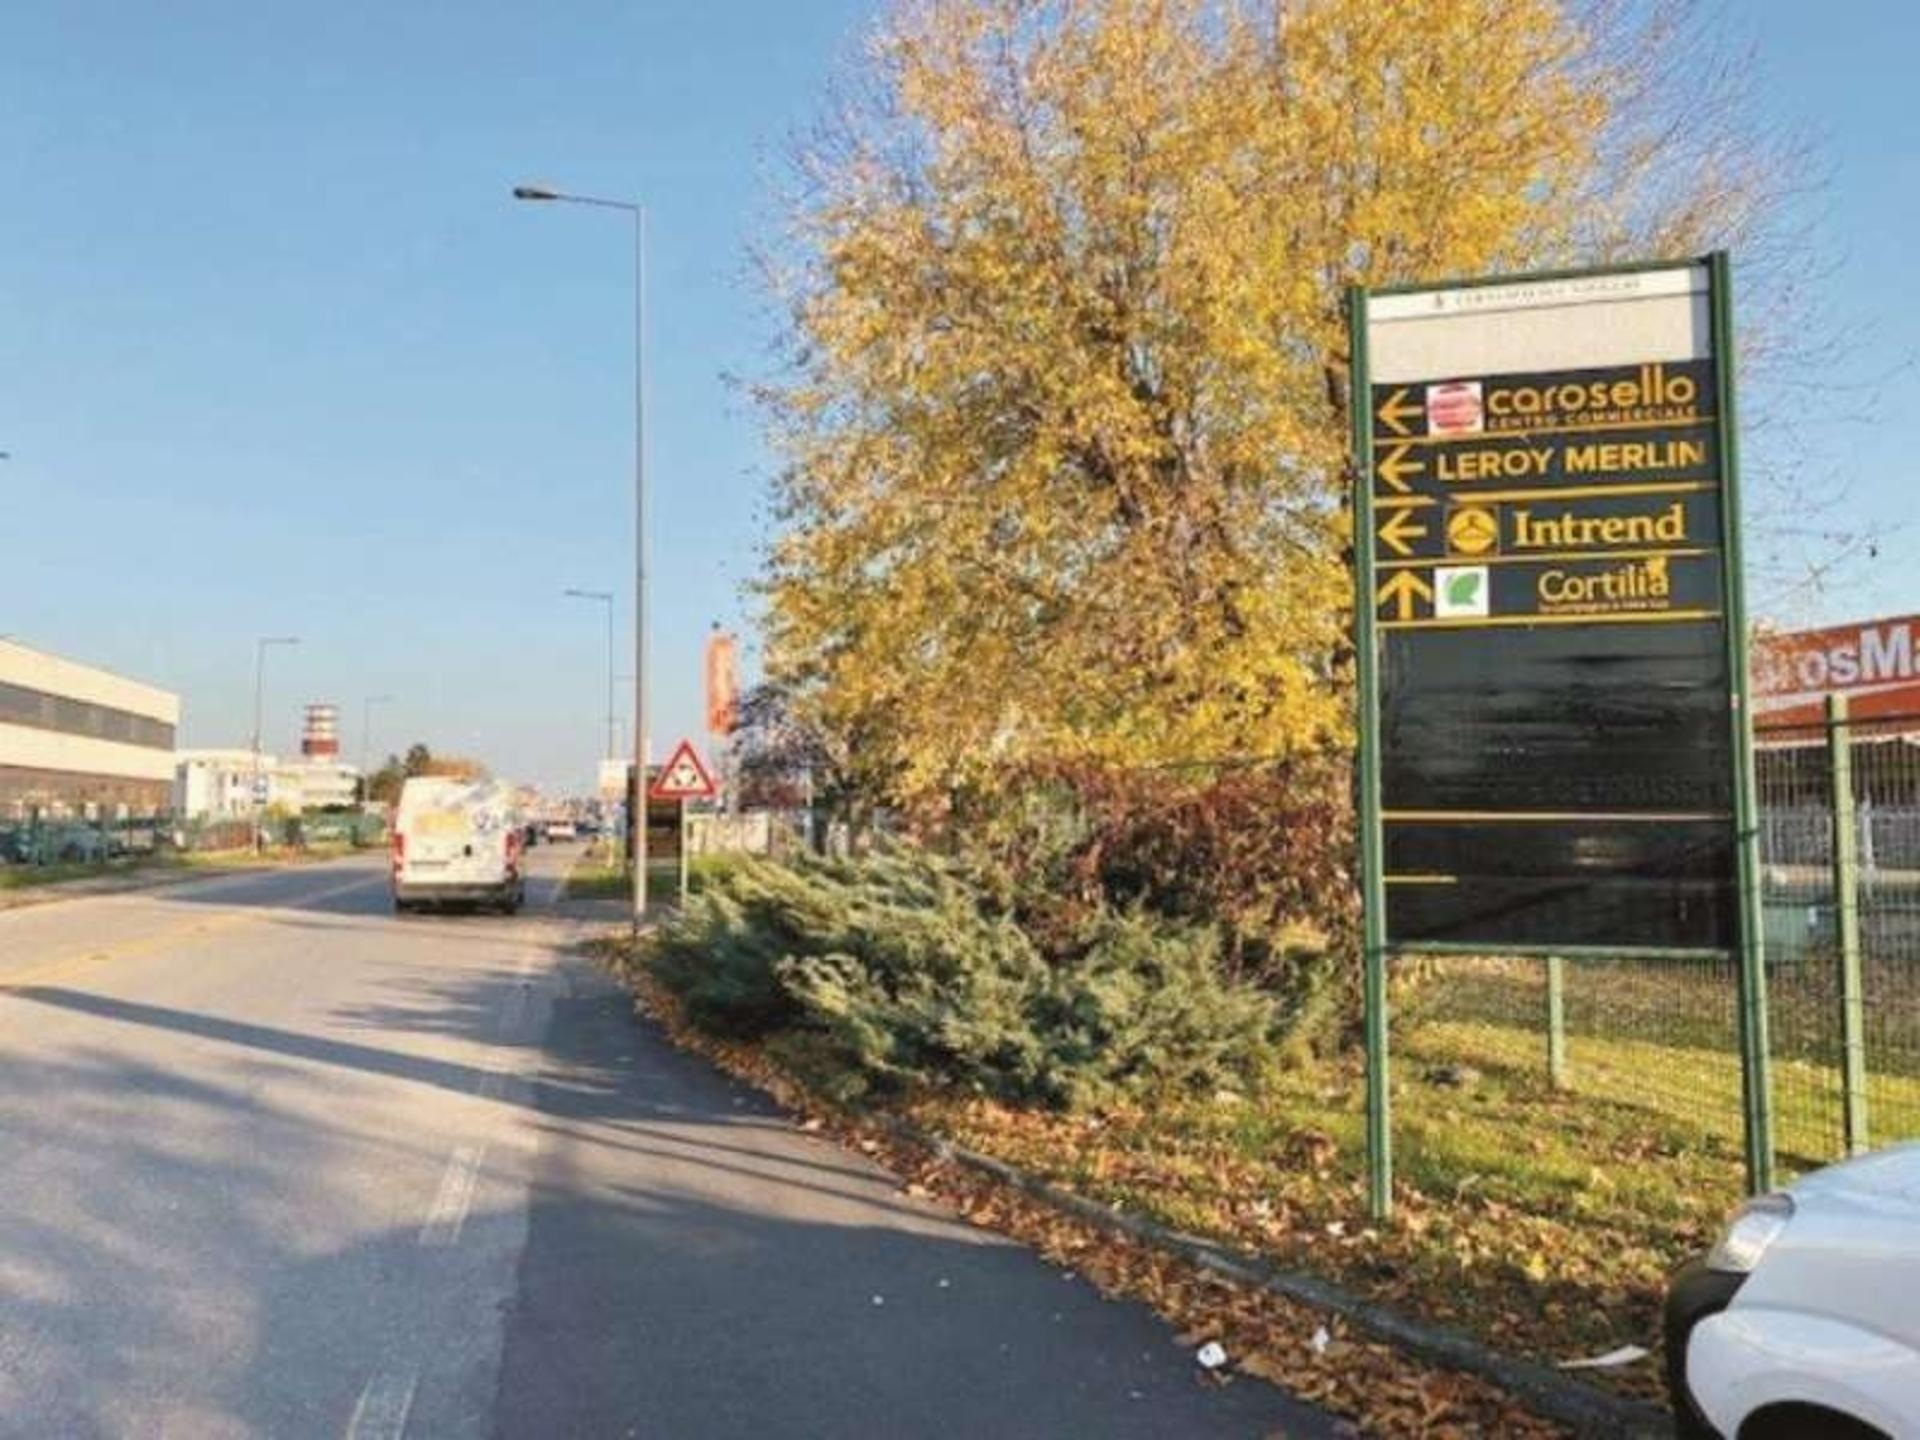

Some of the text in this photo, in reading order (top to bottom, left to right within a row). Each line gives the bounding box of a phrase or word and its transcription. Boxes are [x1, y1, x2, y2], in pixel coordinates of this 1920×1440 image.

[1488, 364, 1695, 415] carosello
[1437, 441, 1704, 481] LEROY MERLIN
[1514, 503, 1687, 546] Intrend
[1538, 563, 1669, 602] Cortilia
